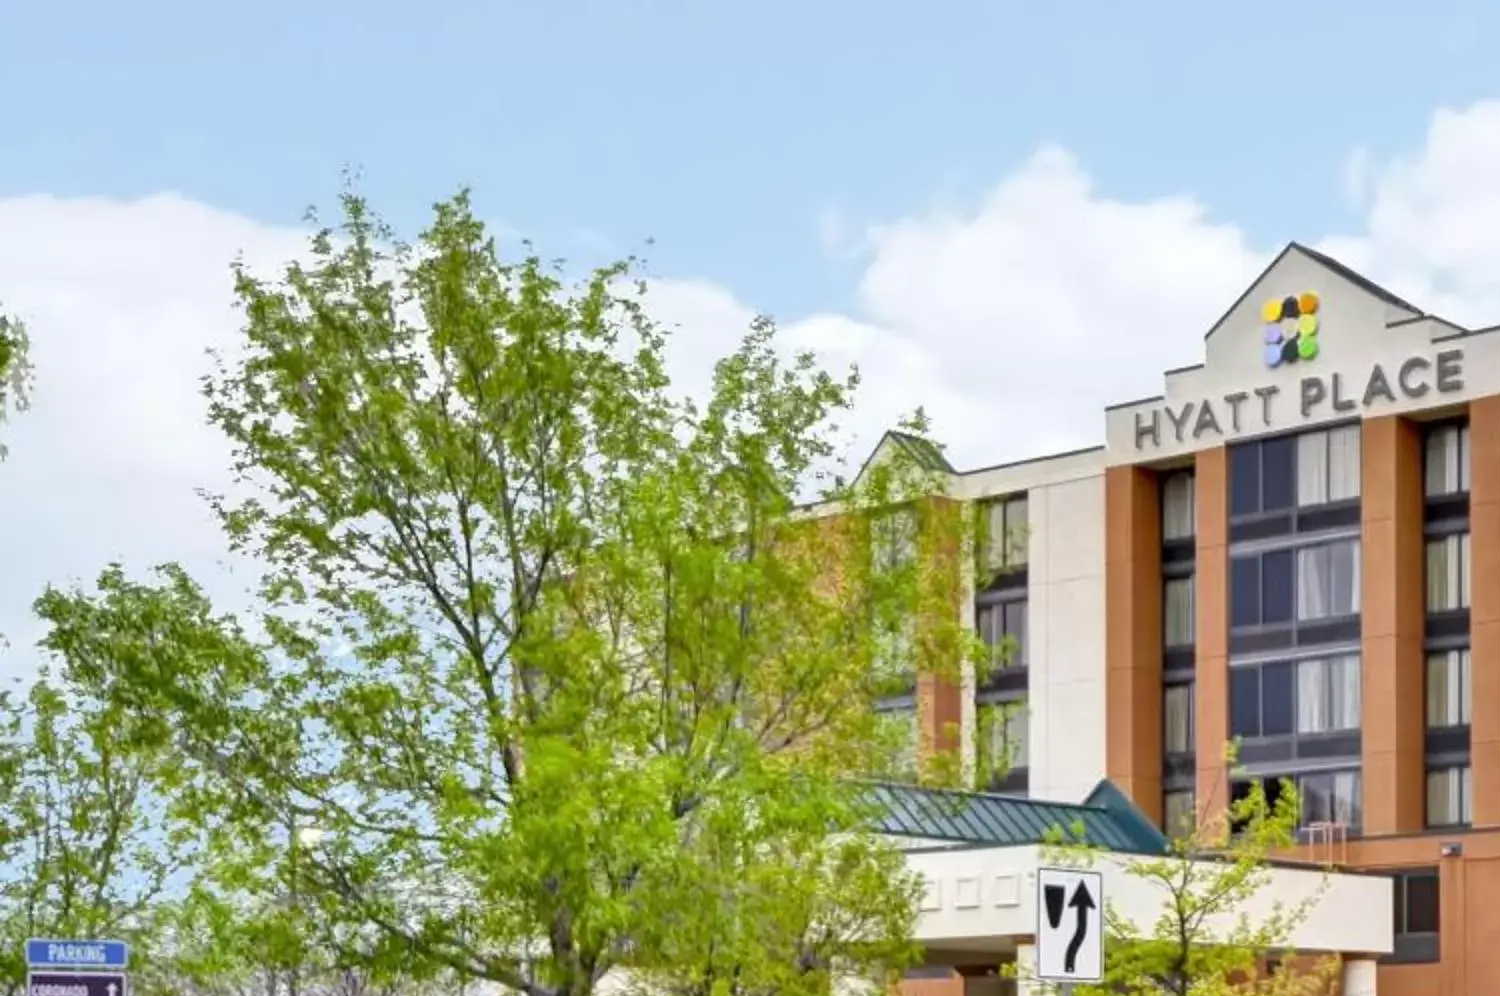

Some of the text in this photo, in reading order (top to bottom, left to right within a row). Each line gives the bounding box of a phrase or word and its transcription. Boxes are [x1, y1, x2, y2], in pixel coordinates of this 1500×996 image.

[1134, 348, 1465, 451] HYATT PLACE
[47, 942, 106, 962] PARKING
